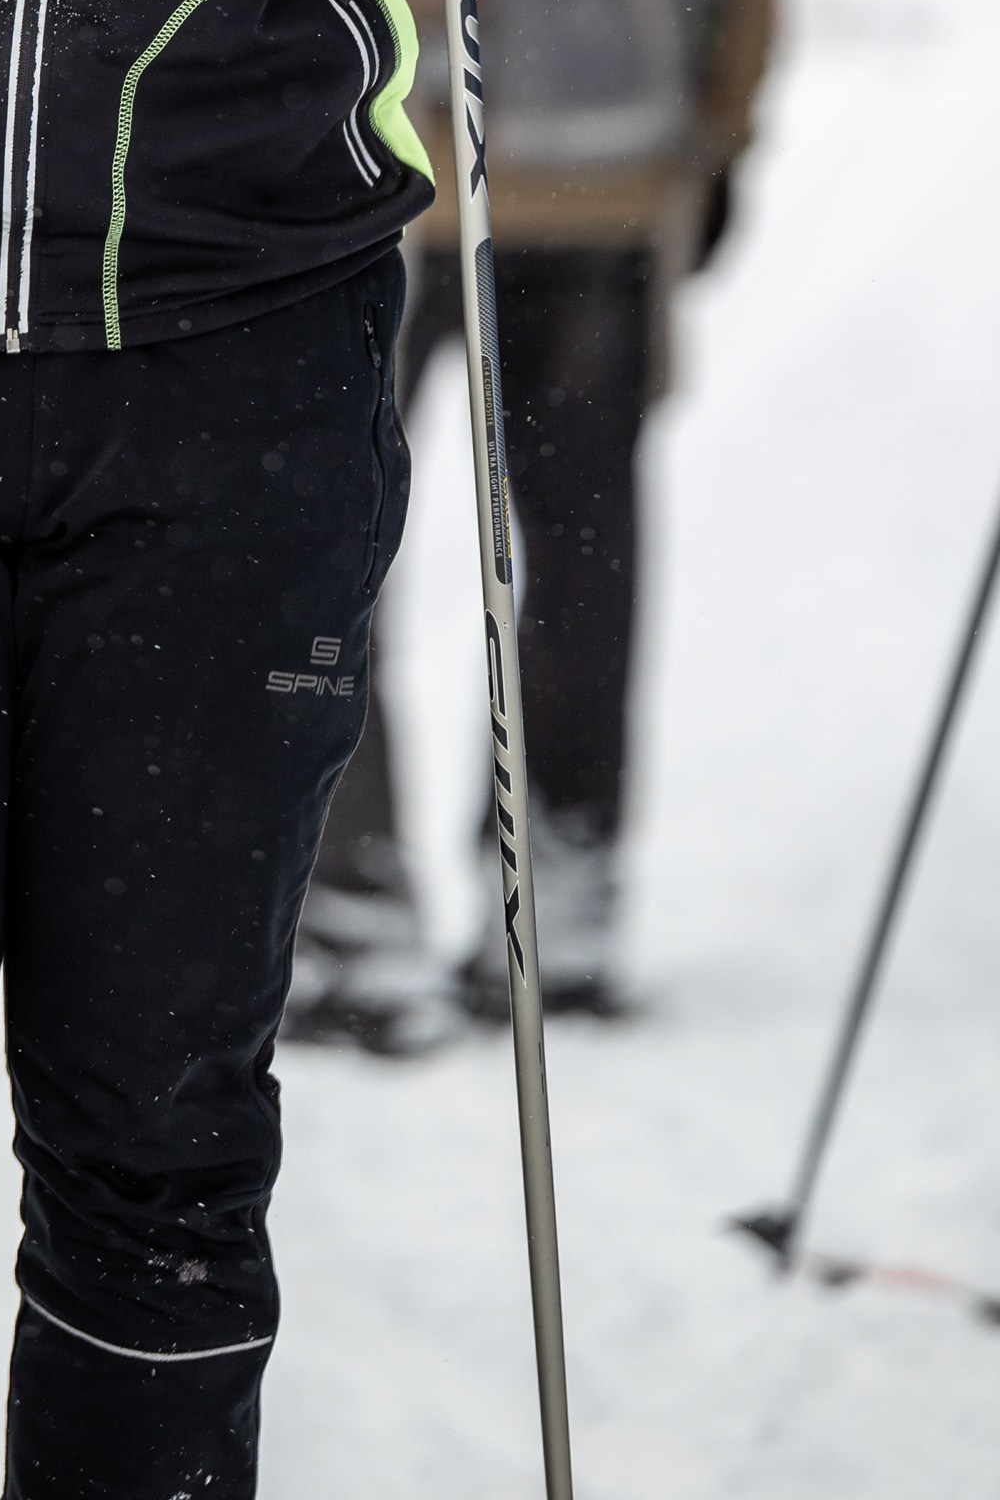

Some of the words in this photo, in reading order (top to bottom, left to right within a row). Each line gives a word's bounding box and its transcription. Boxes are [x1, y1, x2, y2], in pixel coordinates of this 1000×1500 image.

[484, 378, 494, 426] COMPOSITE
[488, 441, 497, 467] ULTRA
[490, 470, 499, 494] LIGHT
[491, 498, 503, 558] PERFORMANCE
[265, 670, 354, 696] SPINE
